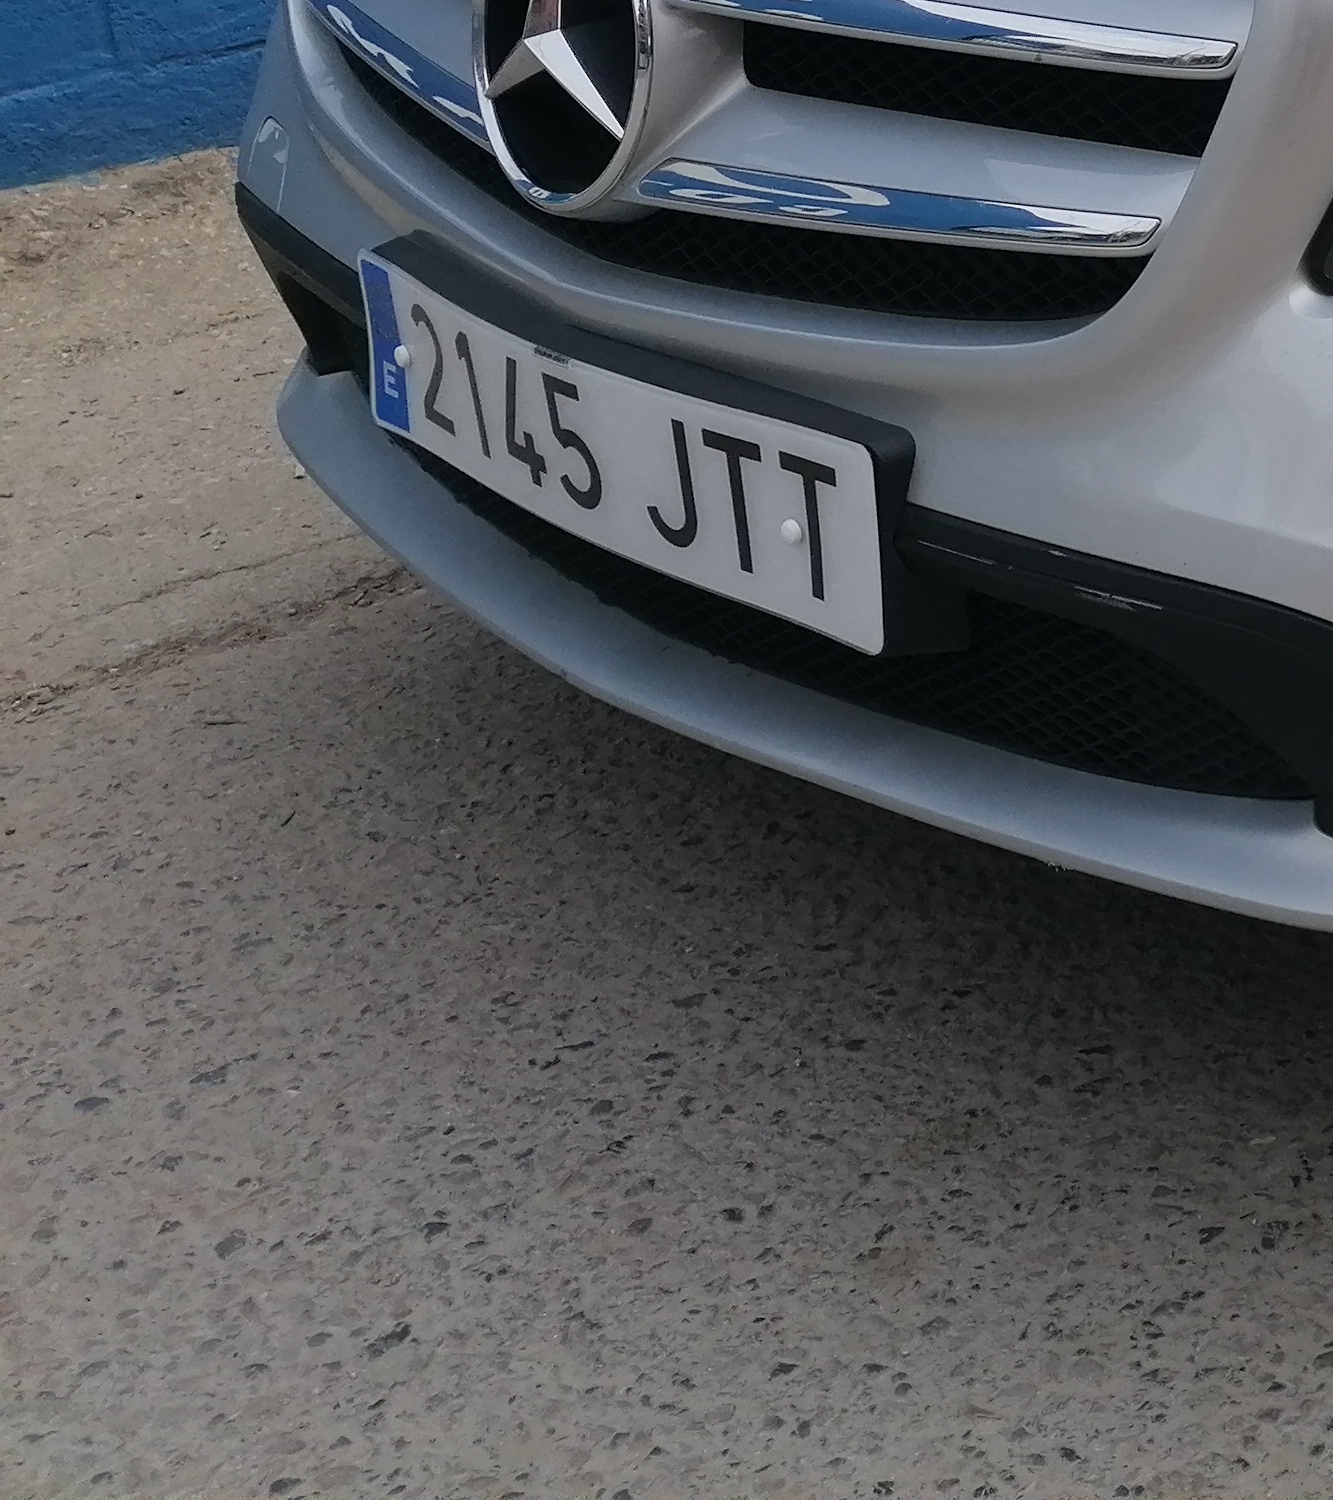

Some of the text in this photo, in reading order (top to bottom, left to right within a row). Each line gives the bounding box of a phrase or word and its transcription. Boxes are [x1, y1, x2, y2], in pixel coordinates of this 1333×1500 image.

[383, 360, 400, 400] E
[410, 303, 837, 602] 2145 JTT
